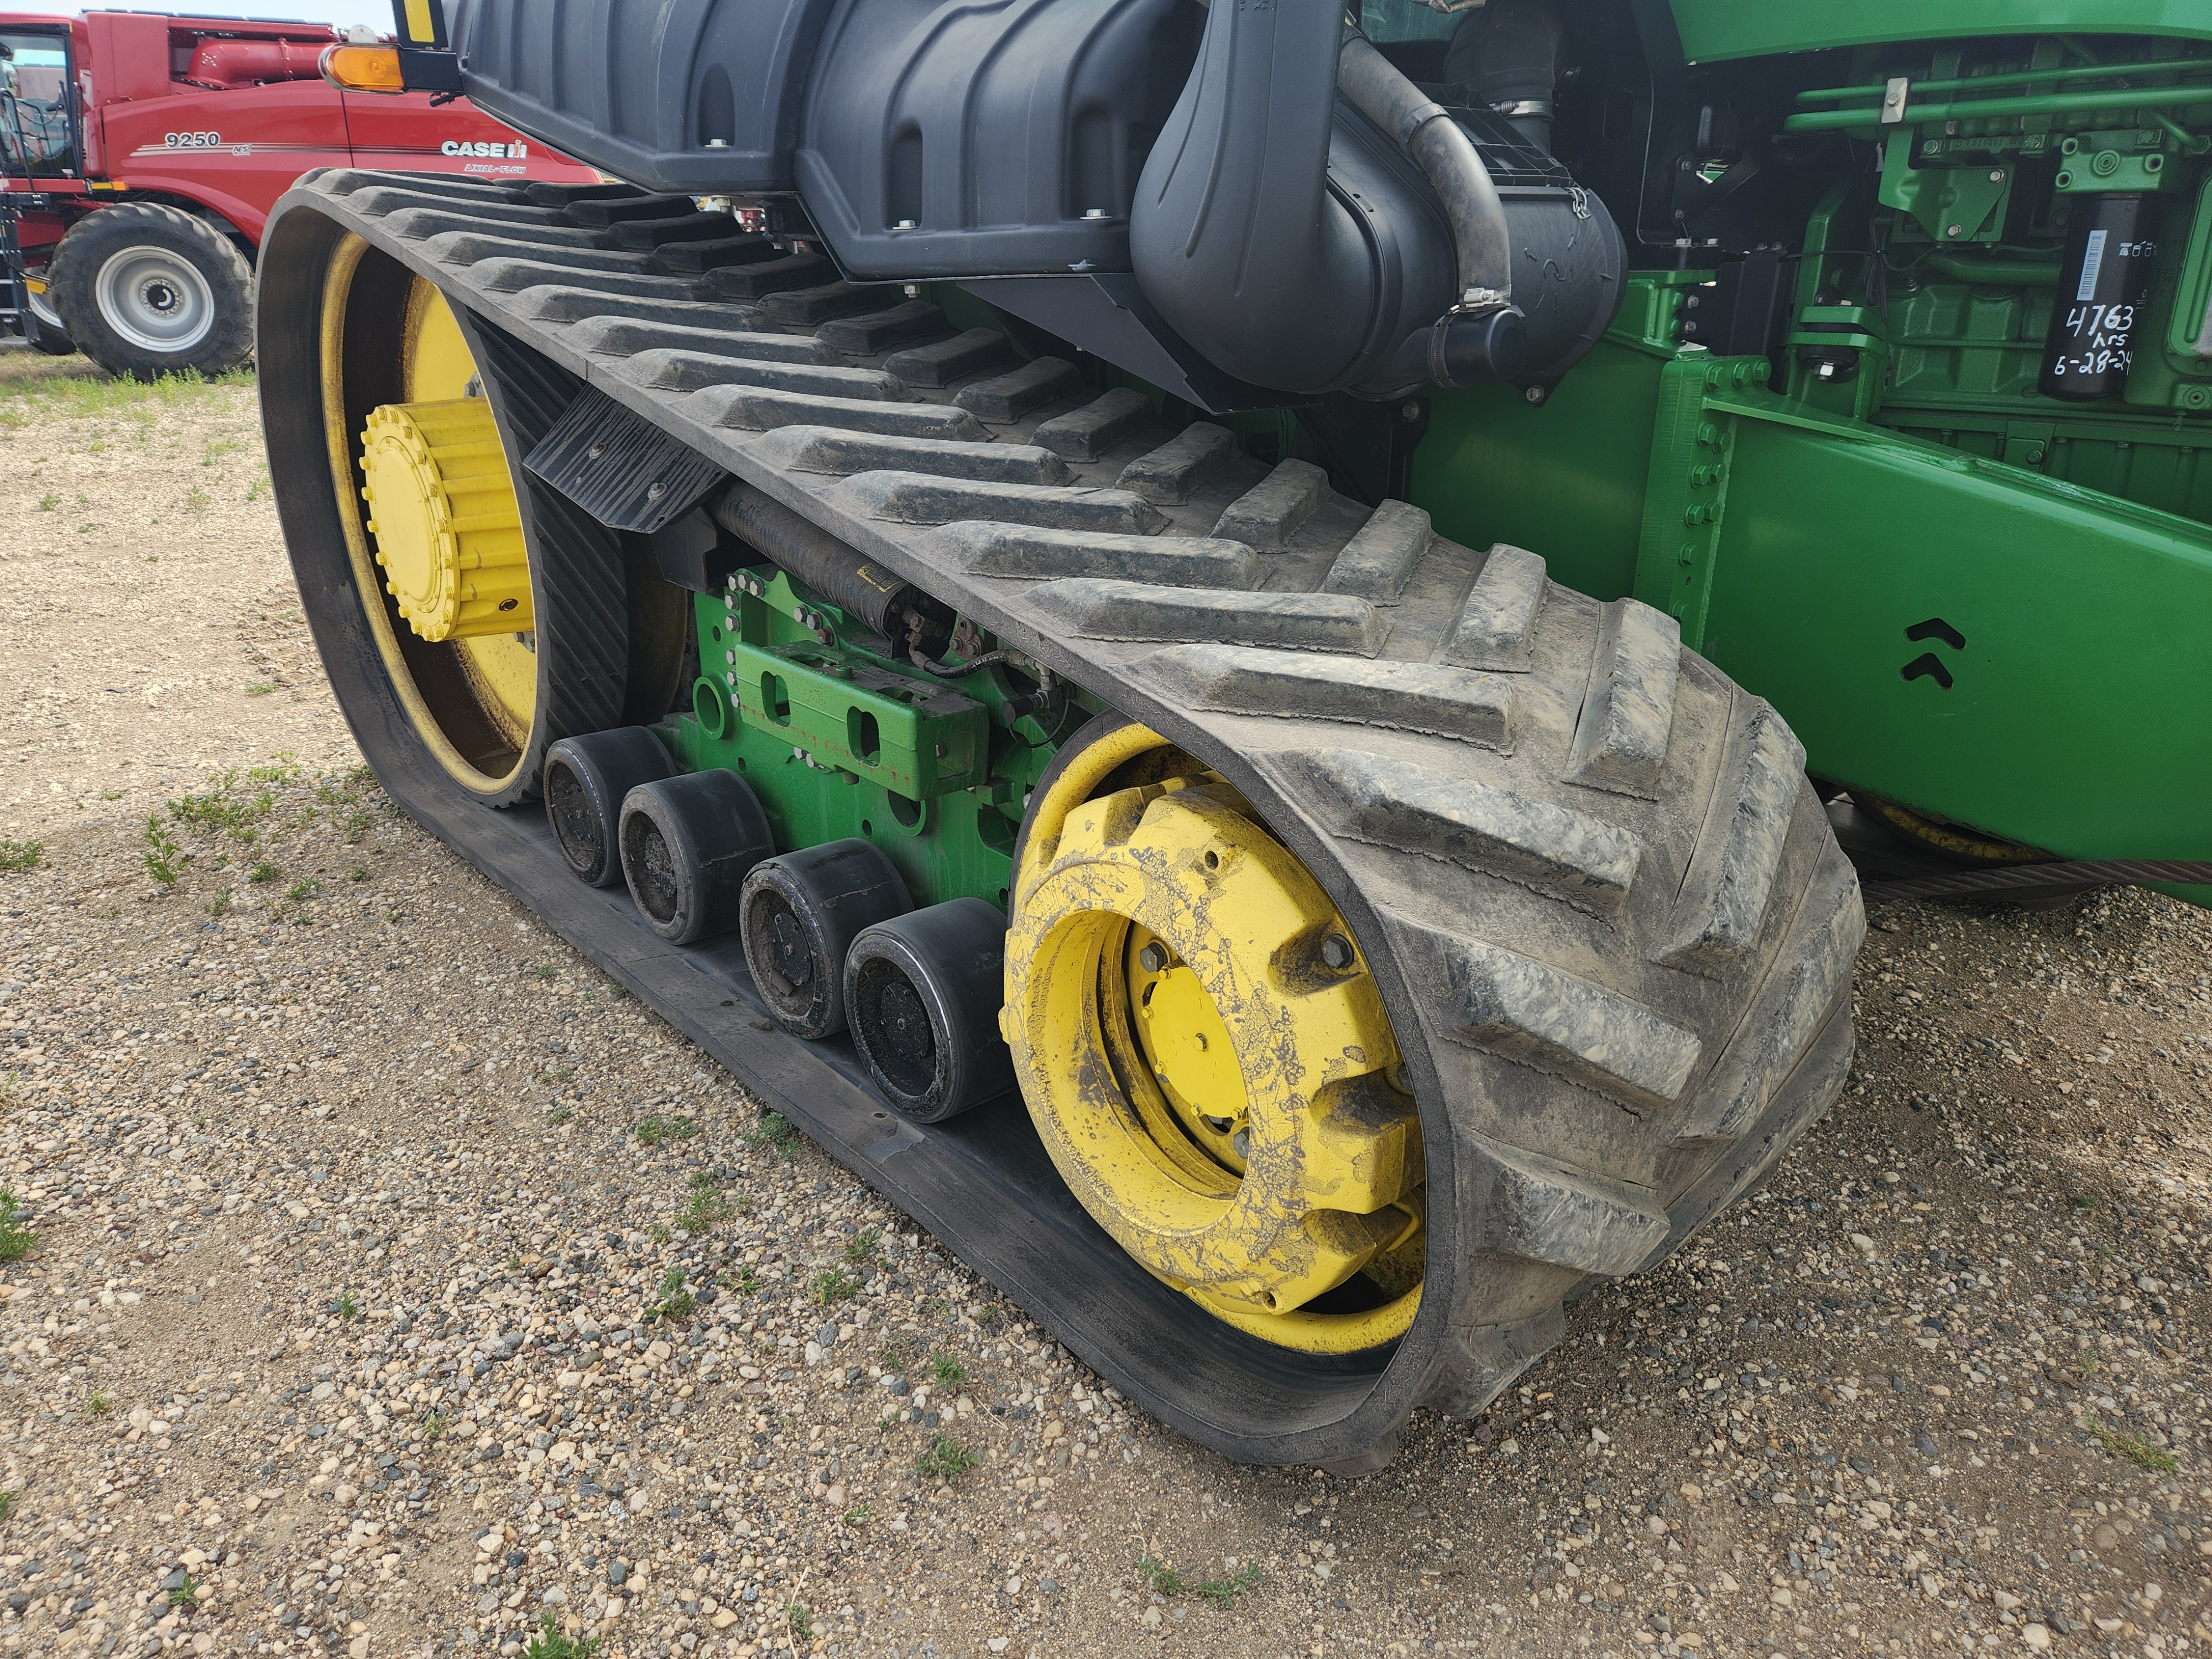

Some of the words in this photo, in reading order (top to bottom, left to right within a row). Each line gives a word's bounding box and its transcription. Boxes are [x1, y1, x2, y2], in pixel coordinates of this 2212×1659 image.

[165, 132, 220, 148] 9250
[441, 140, 505, 158] CASE
[465, 164, 526, 174] AXIAL-FLOW
[2066, 304, 2133, 337] 4763
[2092, 332, 2128, 348] hrs
[2054, 349, 2133, 375] 6-28-24
